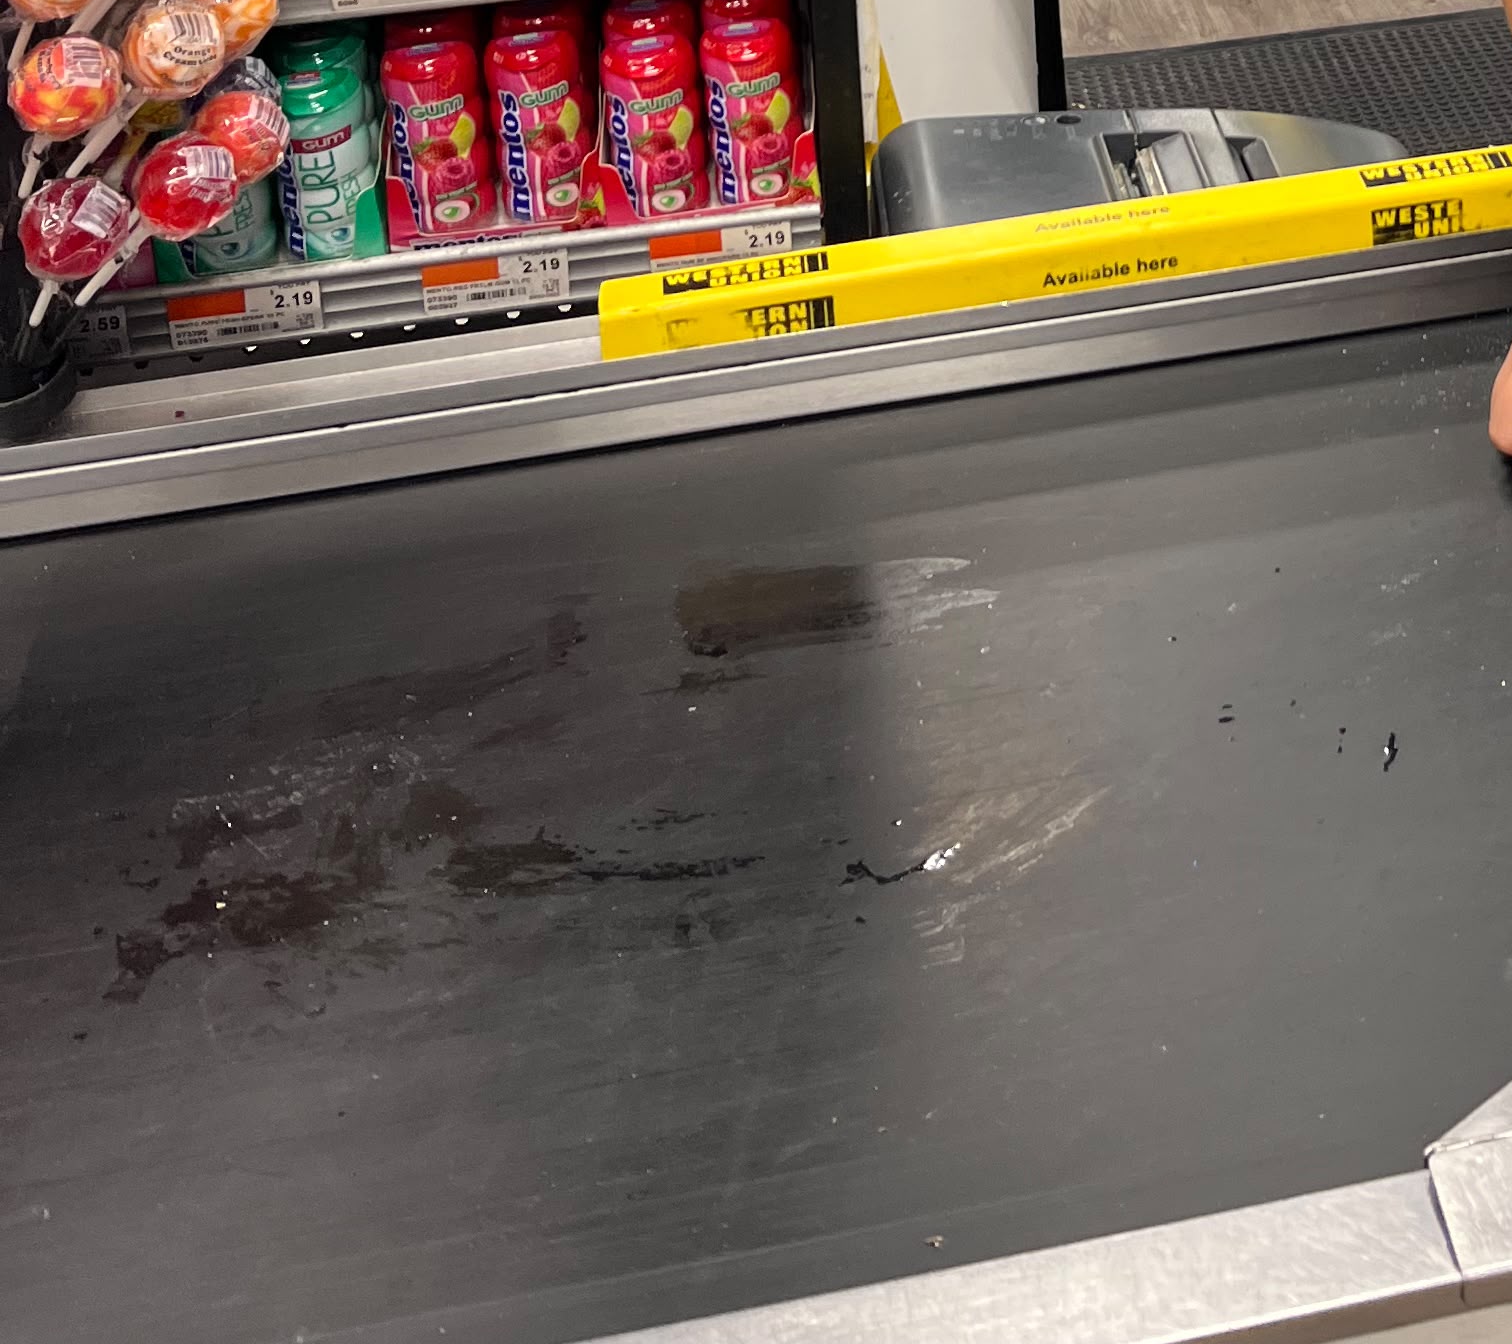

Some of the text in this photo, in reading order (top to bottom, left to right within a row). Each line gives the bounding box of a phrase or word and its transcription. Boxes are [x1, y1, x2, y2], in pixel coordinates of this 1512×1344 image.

[498, 89, 533, 222] mentos
[1361, 153, 1489, 181] WESTERN
[1404, 162, 1489, 181] UNION
[301, 150, 343, 225] PURE
[1035, 206, 1170, 233] Available here
[1374, 199, 1462, 228] WESTE
[749, 230, 785, 248] 2.19
[1413, 216, 1462, 240] UNI
[523, 258, 560, 274] 2.19
[666, 256, 802, 286] WESTERN
[709, 266, 802, 288] UNION
[1043, 255, 1178, 288] Available here
[275, 291, 313, 309] 2.19
[80, 316, 120, 334] 2.59
